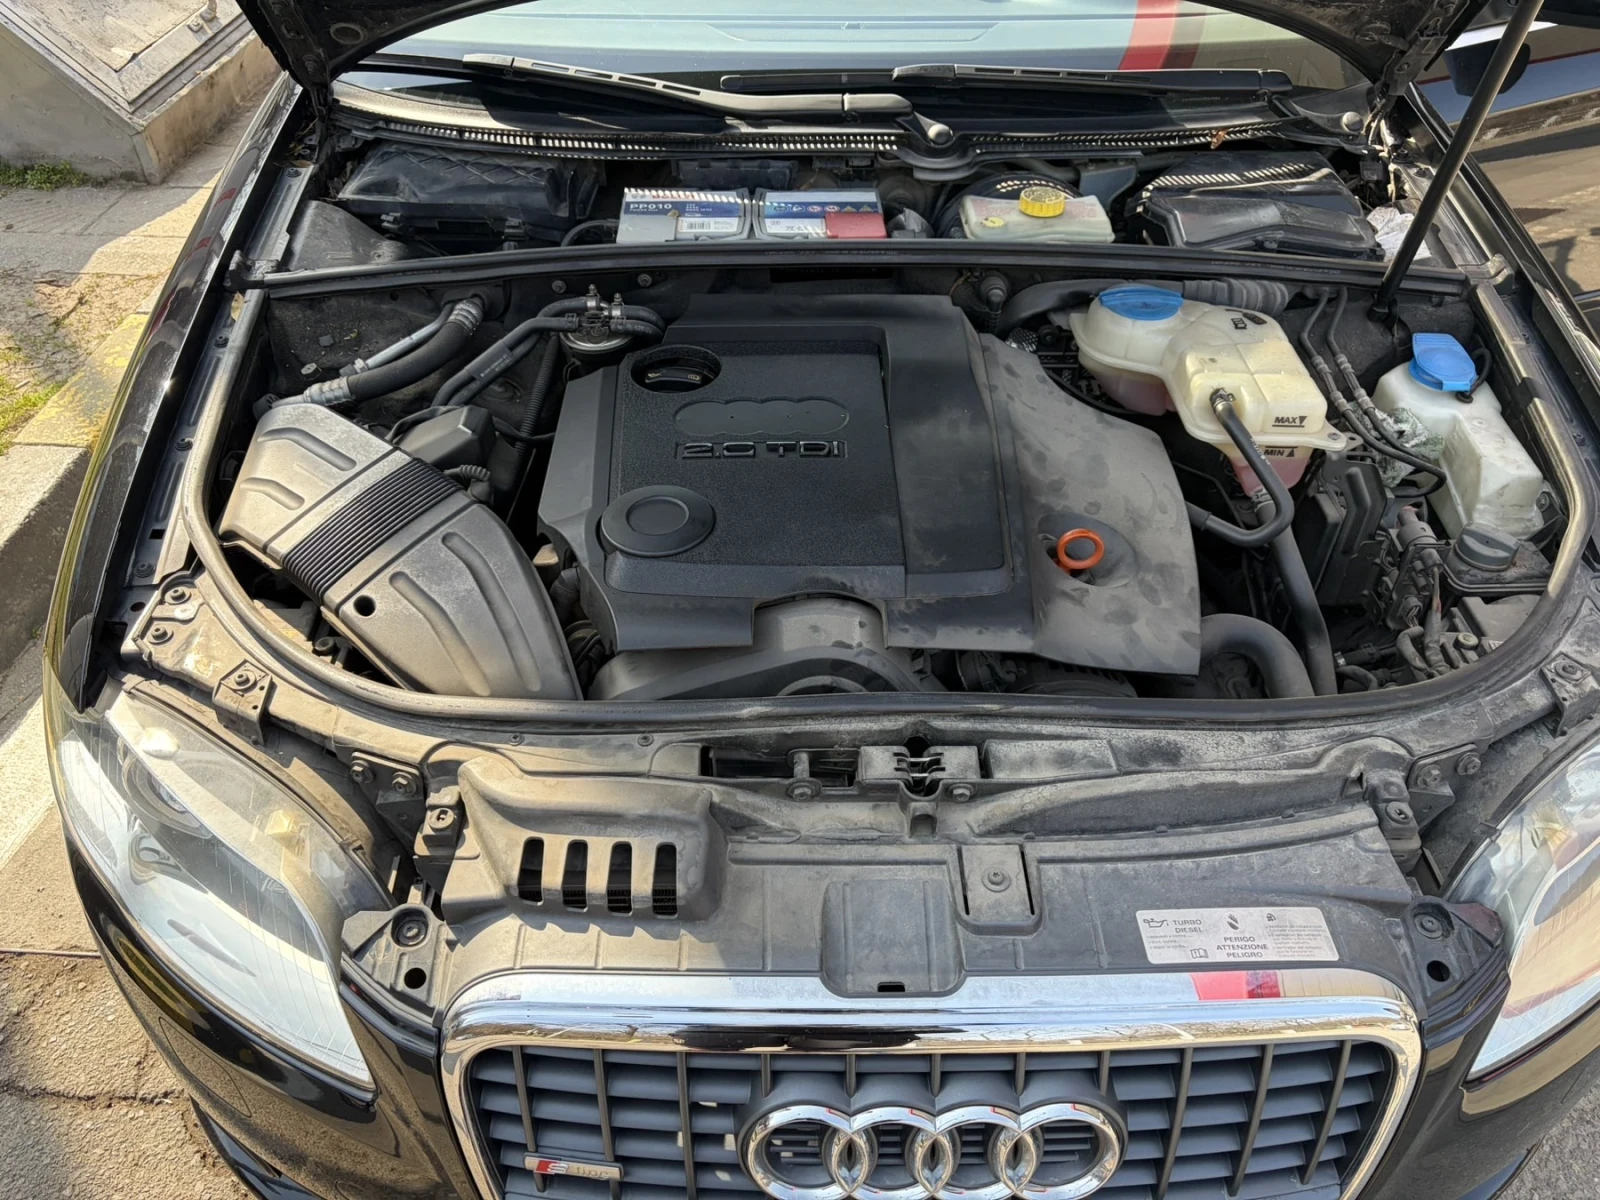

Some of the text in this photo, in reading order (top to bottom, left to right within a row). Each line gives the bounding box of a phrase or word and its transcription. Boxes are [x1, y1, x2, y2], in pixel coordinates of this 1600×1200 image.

[1274, 416, 1298, 424] MAX
[682, 441, 839, 458] 2.0 TDI
[1216, 943, 1269, 951] ATTENZIONE
[1226, 951, 1264, 959] PELIGRO
